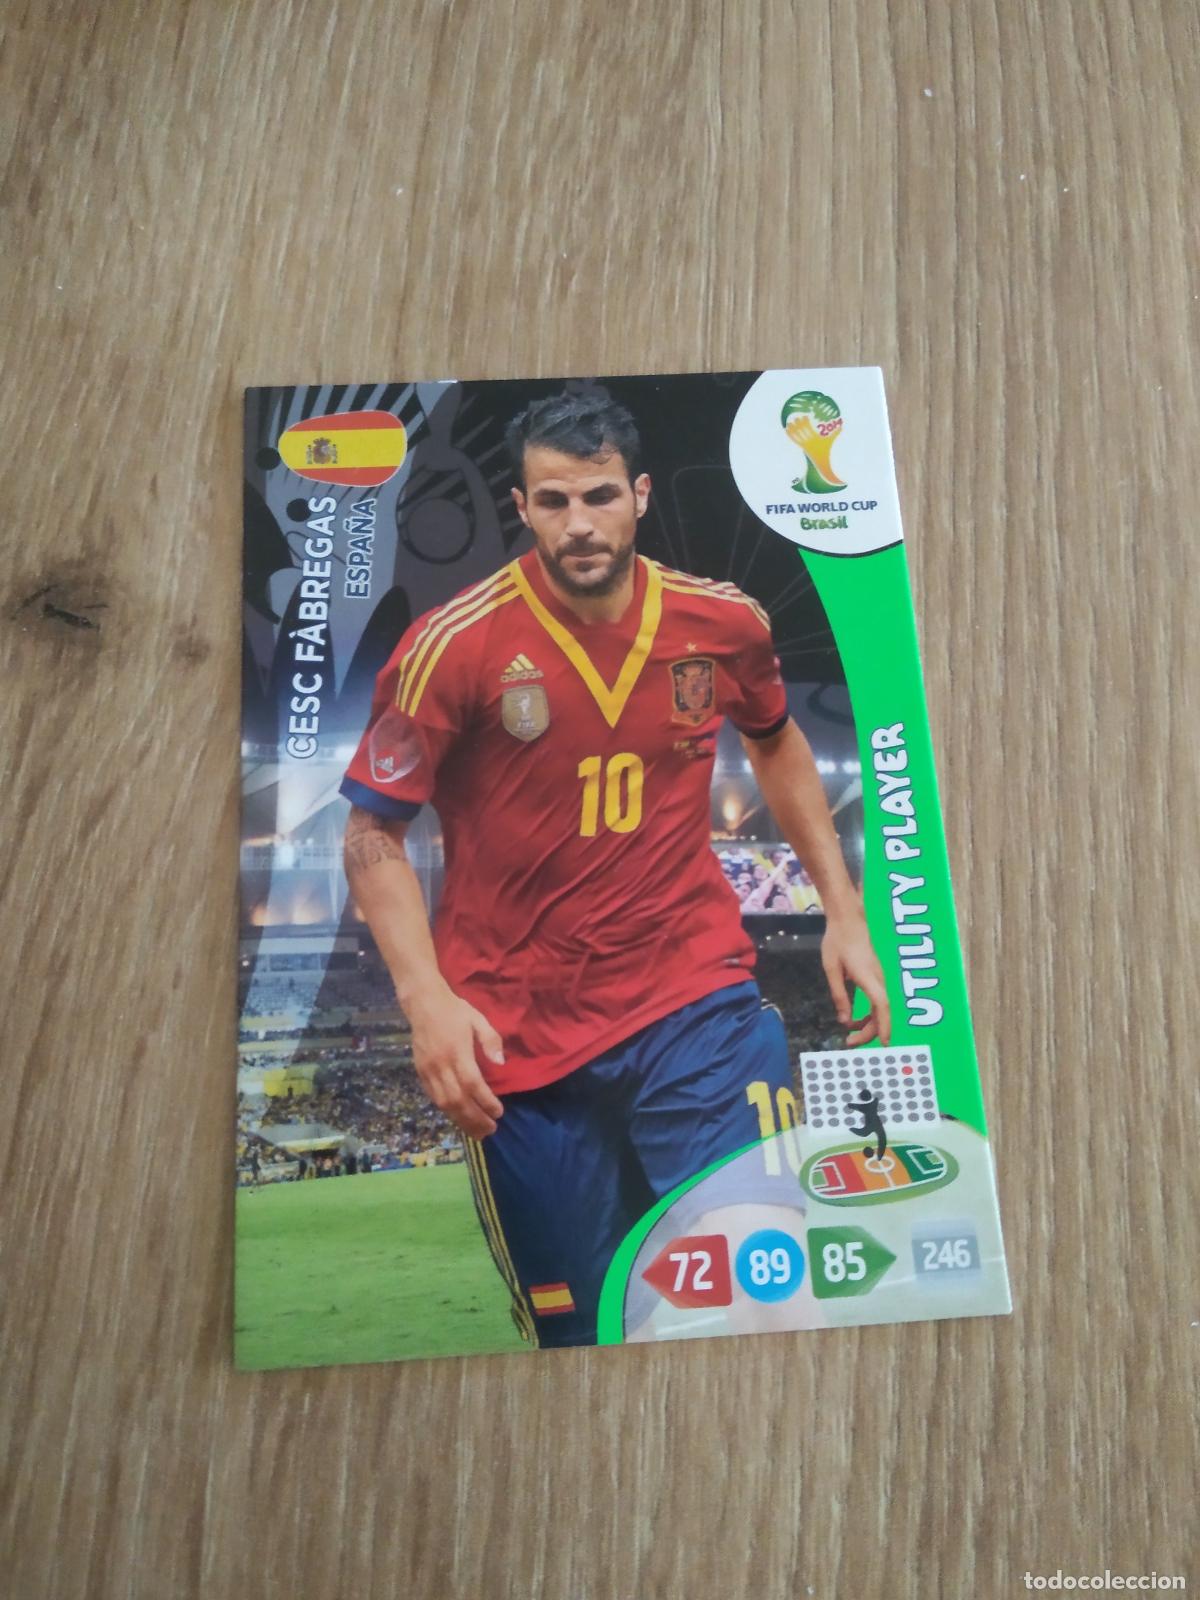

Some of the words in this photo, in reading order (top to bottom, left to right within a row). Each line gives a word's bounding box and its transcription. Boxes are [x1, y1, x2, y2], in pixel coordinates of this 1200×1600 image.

[817, 418, 843, 436] 2014
[765, 504, 796, 515] FIFA
[798, 501, 849, 513] WORLD
[851, 500, 878, 512] CUP
[800, 515, 848, 531] Brasil
[343, 497, 377, 600] ESPAÑA
[288, 496, 337, 662] FÀBREGAS
[500, 669, 544, 683] adidas
[286, 672, 323, 759] CESC
[577, 752, 645, 837] 10
[871, 722, 921, 861] PLAYER
[888, 872, 944, 1027] UTILITY
[669, 1251, 714, 1292] 72
[749, 1248, 791, 1286] 89
[822, 1241, 867, 1283] 85
[921, 1238, 972, 1271] 246
